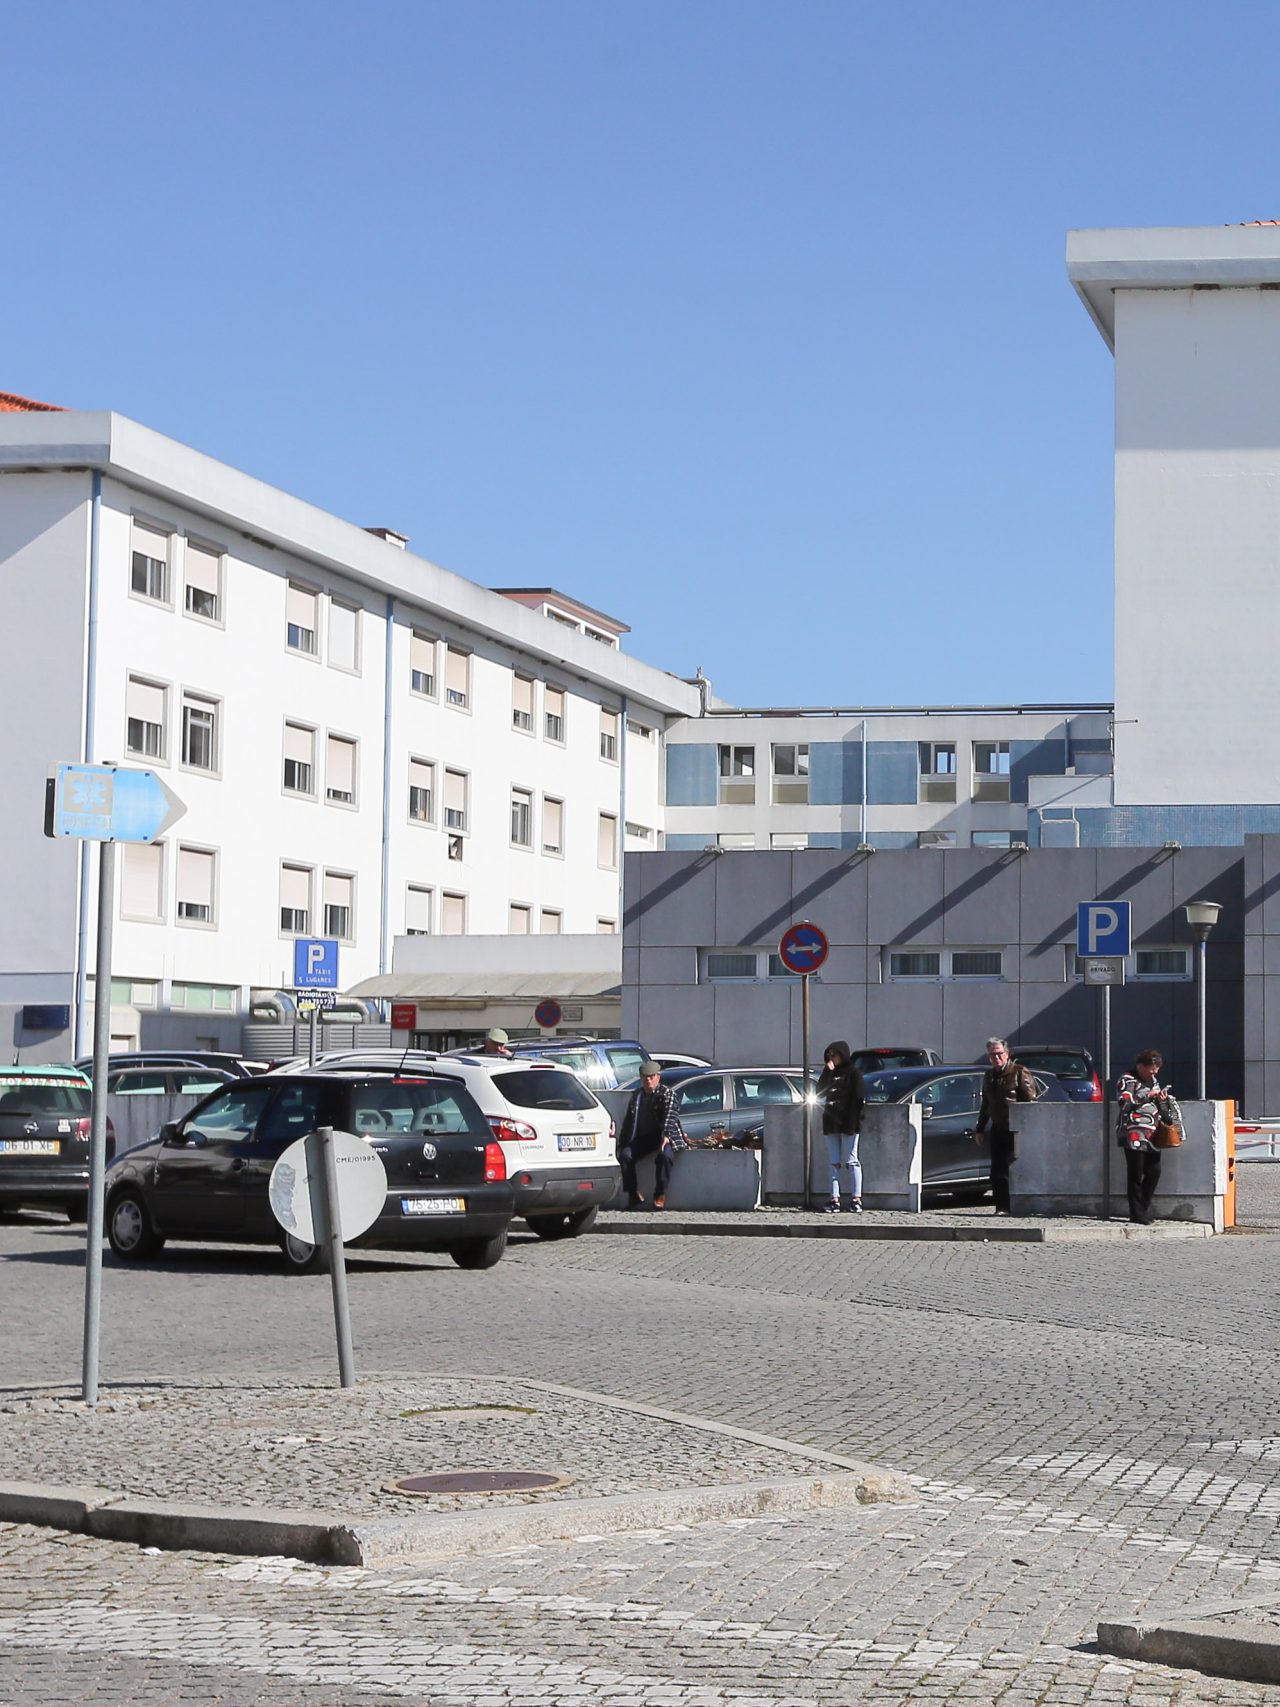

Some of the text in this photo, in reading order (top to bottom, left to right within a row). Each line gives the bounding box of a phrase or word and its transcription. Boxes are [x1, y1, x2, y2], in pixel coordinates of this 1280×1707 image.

[1088, 906, 1119, 953] P
[307, 944, 325, 975] P
[335, 1155, 376, 1164] CME/01995
